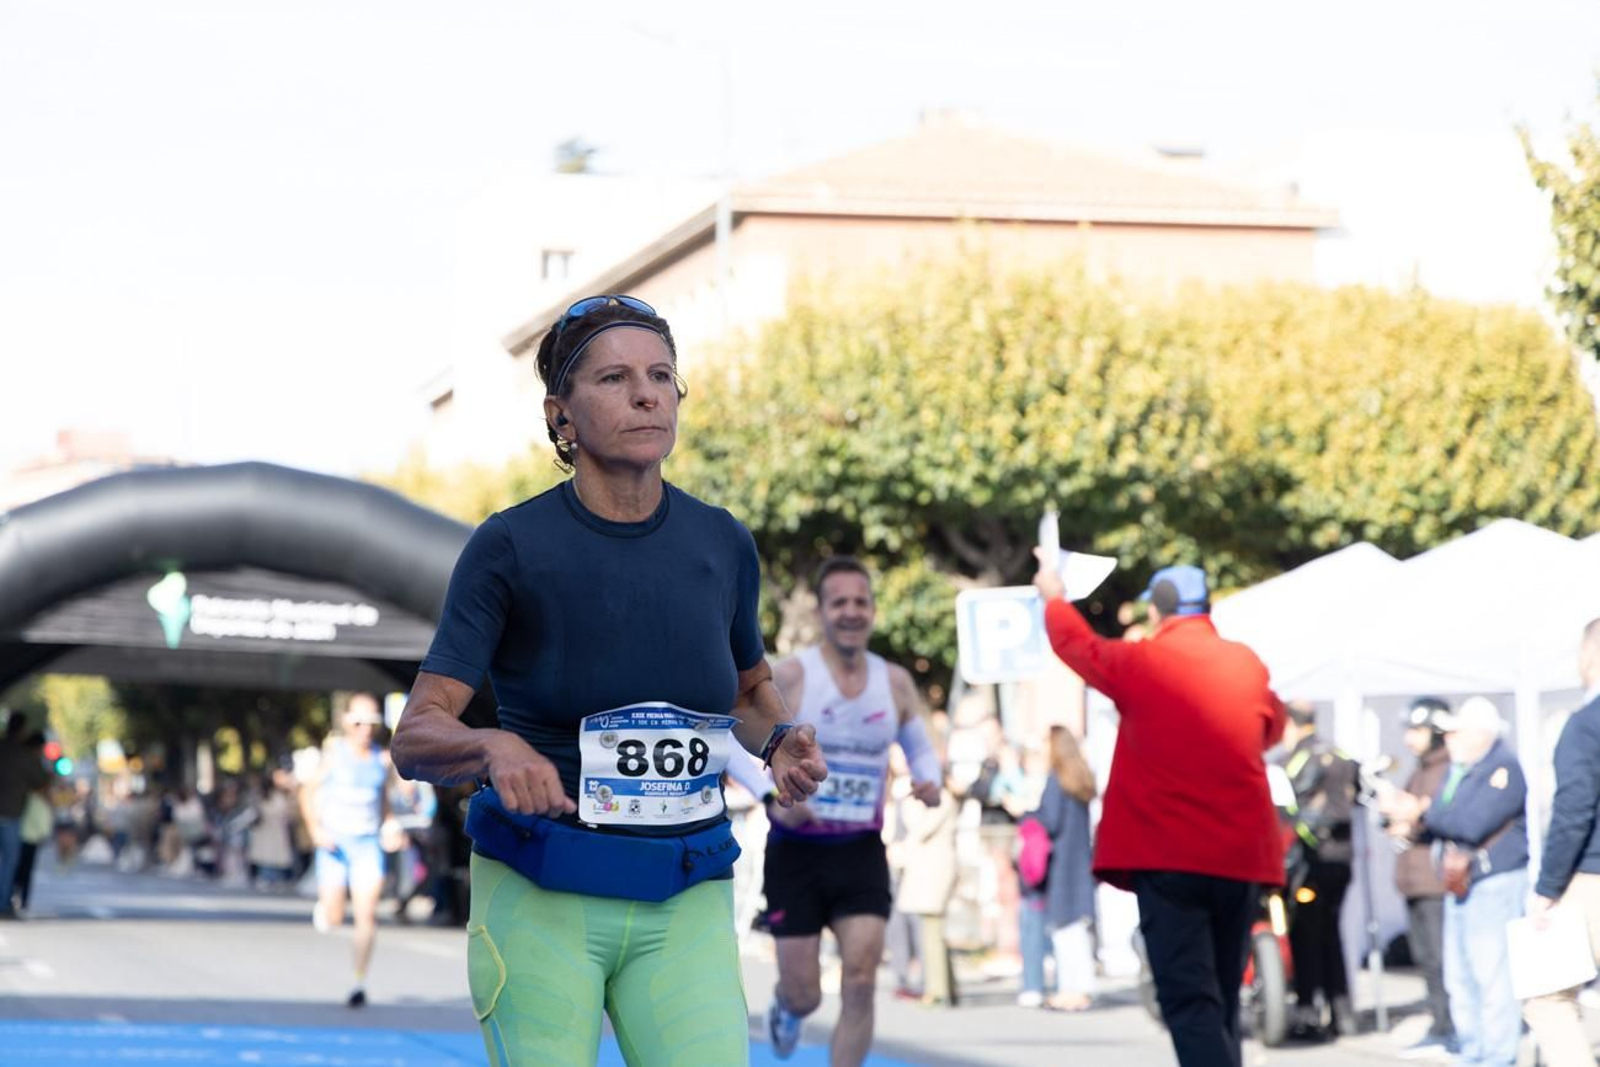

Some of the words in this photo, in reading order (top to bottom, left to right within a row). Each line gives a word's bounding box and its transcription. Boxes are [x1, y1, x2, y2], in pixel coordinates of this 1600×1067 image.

[976, 600, 1032, 673] P
[616, 737, 710, 778] 868
[639, 781, 683, 792] JOSEFINA
